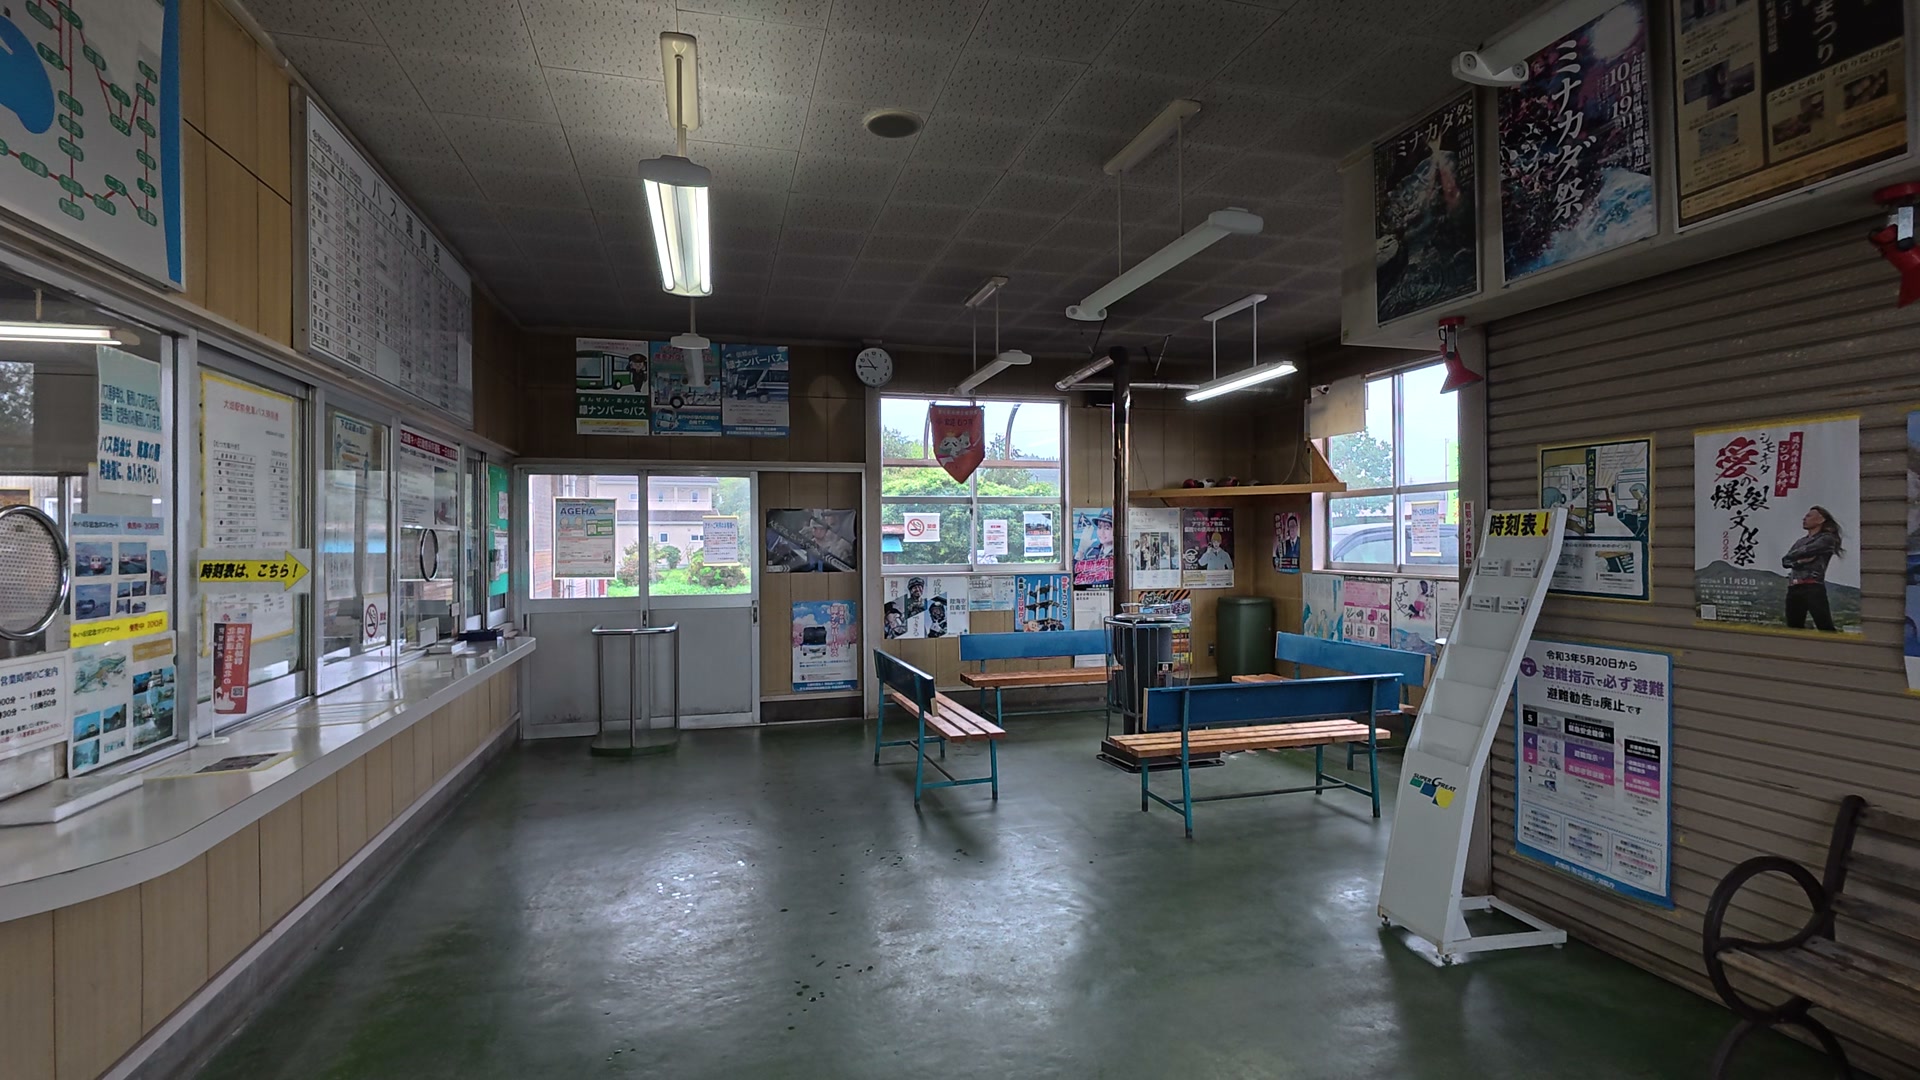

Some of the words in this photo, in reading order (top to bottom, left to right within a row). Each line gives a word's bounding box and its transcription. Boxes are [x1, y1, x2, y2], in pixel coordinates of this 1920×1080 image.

[1609, 62, 1633, 128] 10月19日
[1396, 98, 1472, 158] ミナカダ祭
[1552, 39, 1597, 222] ミナカダ祭
[579, 405, 647, 416] 緑ナンバーのバス
[1759, 433, 1775, 475] シモキタ
[1711, 479, 1770, 511] 爆裂
[560, 507, 596, 516] AGEHA
[1489, 512, 1538, 536] 時刻表
[1464, 502, 1472, 568] 防犯カメラ作動中
[1729, 510, 1759, 567] 文化祭
[933, 579, 942, 595] 成長
[1723, 577, 1756, 586] 11月3日
[830, 605, 839, 657] 緑ナンバーバス
[1525, 666, 1531, 674] 4
[1546, 650, 1638, 671] 令和3年5月20日から
[0, 666, 58, 687] 営業時間のご案内
[1542, 665, 1665, 698] 避難指示で必ず避難
[1546, 687, 1642, 715] 避難勧告は廃止です
[1527, 714, 1533, 722] 5
[1527, 737, 1533, 745] 4
[1527, 752, 1533, 761] 3
[1527, 765, 1533, 773] 2
[1413, 773, 1432, 784] SUPER
[1432, 777, 1457, 792] GREAT
